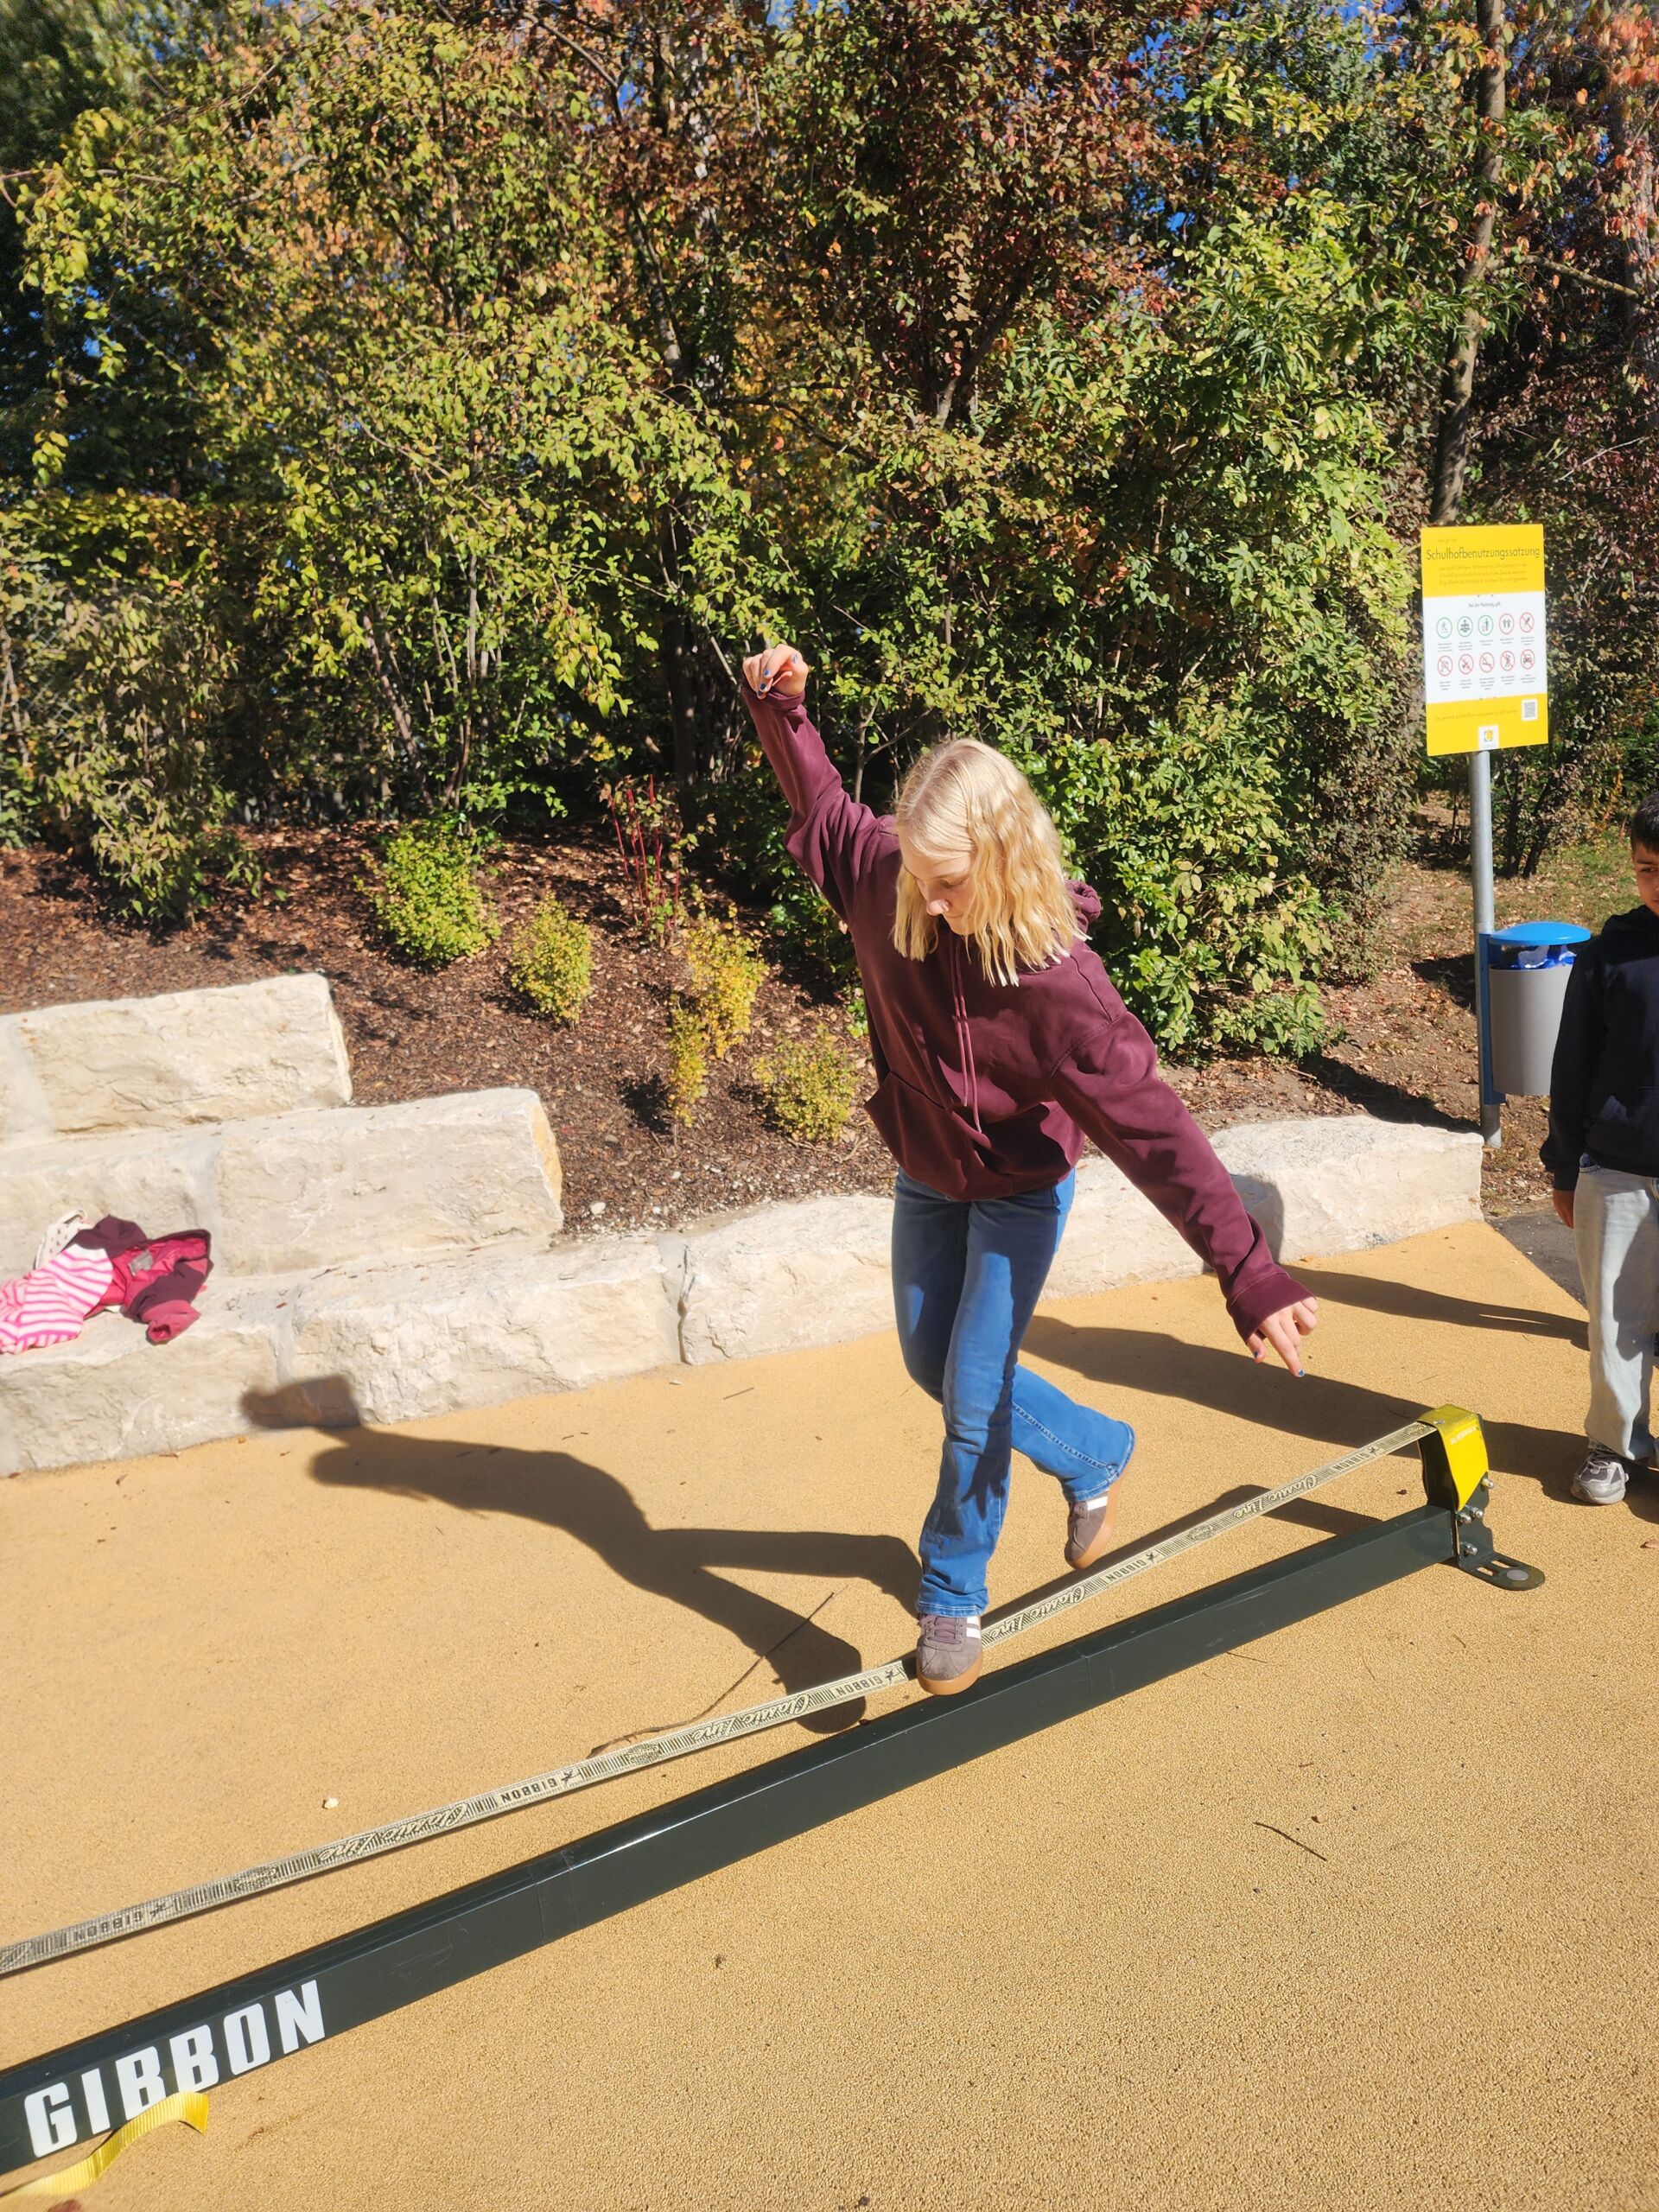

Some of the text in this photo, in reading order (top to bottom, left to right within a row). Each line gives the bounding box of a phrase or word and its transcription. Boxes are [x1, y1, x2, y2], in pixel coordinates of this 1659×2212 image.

[1427, 547, 1540, 560] Schulhofbenutzungssatzung
[1233, 1452, 1370, 1520] GIBBON Classic Line
[989, 1559, 1147, 1641] GIBBON Classic Line
[690, 1675, 884, 1741] GIBBON Classic Line
[317, 1777, 558, 1862] GIBBON Classic Line
[73, 1910, 143, 1942] GIBBON
[24, 1980, 326, 2158] GIBBON
